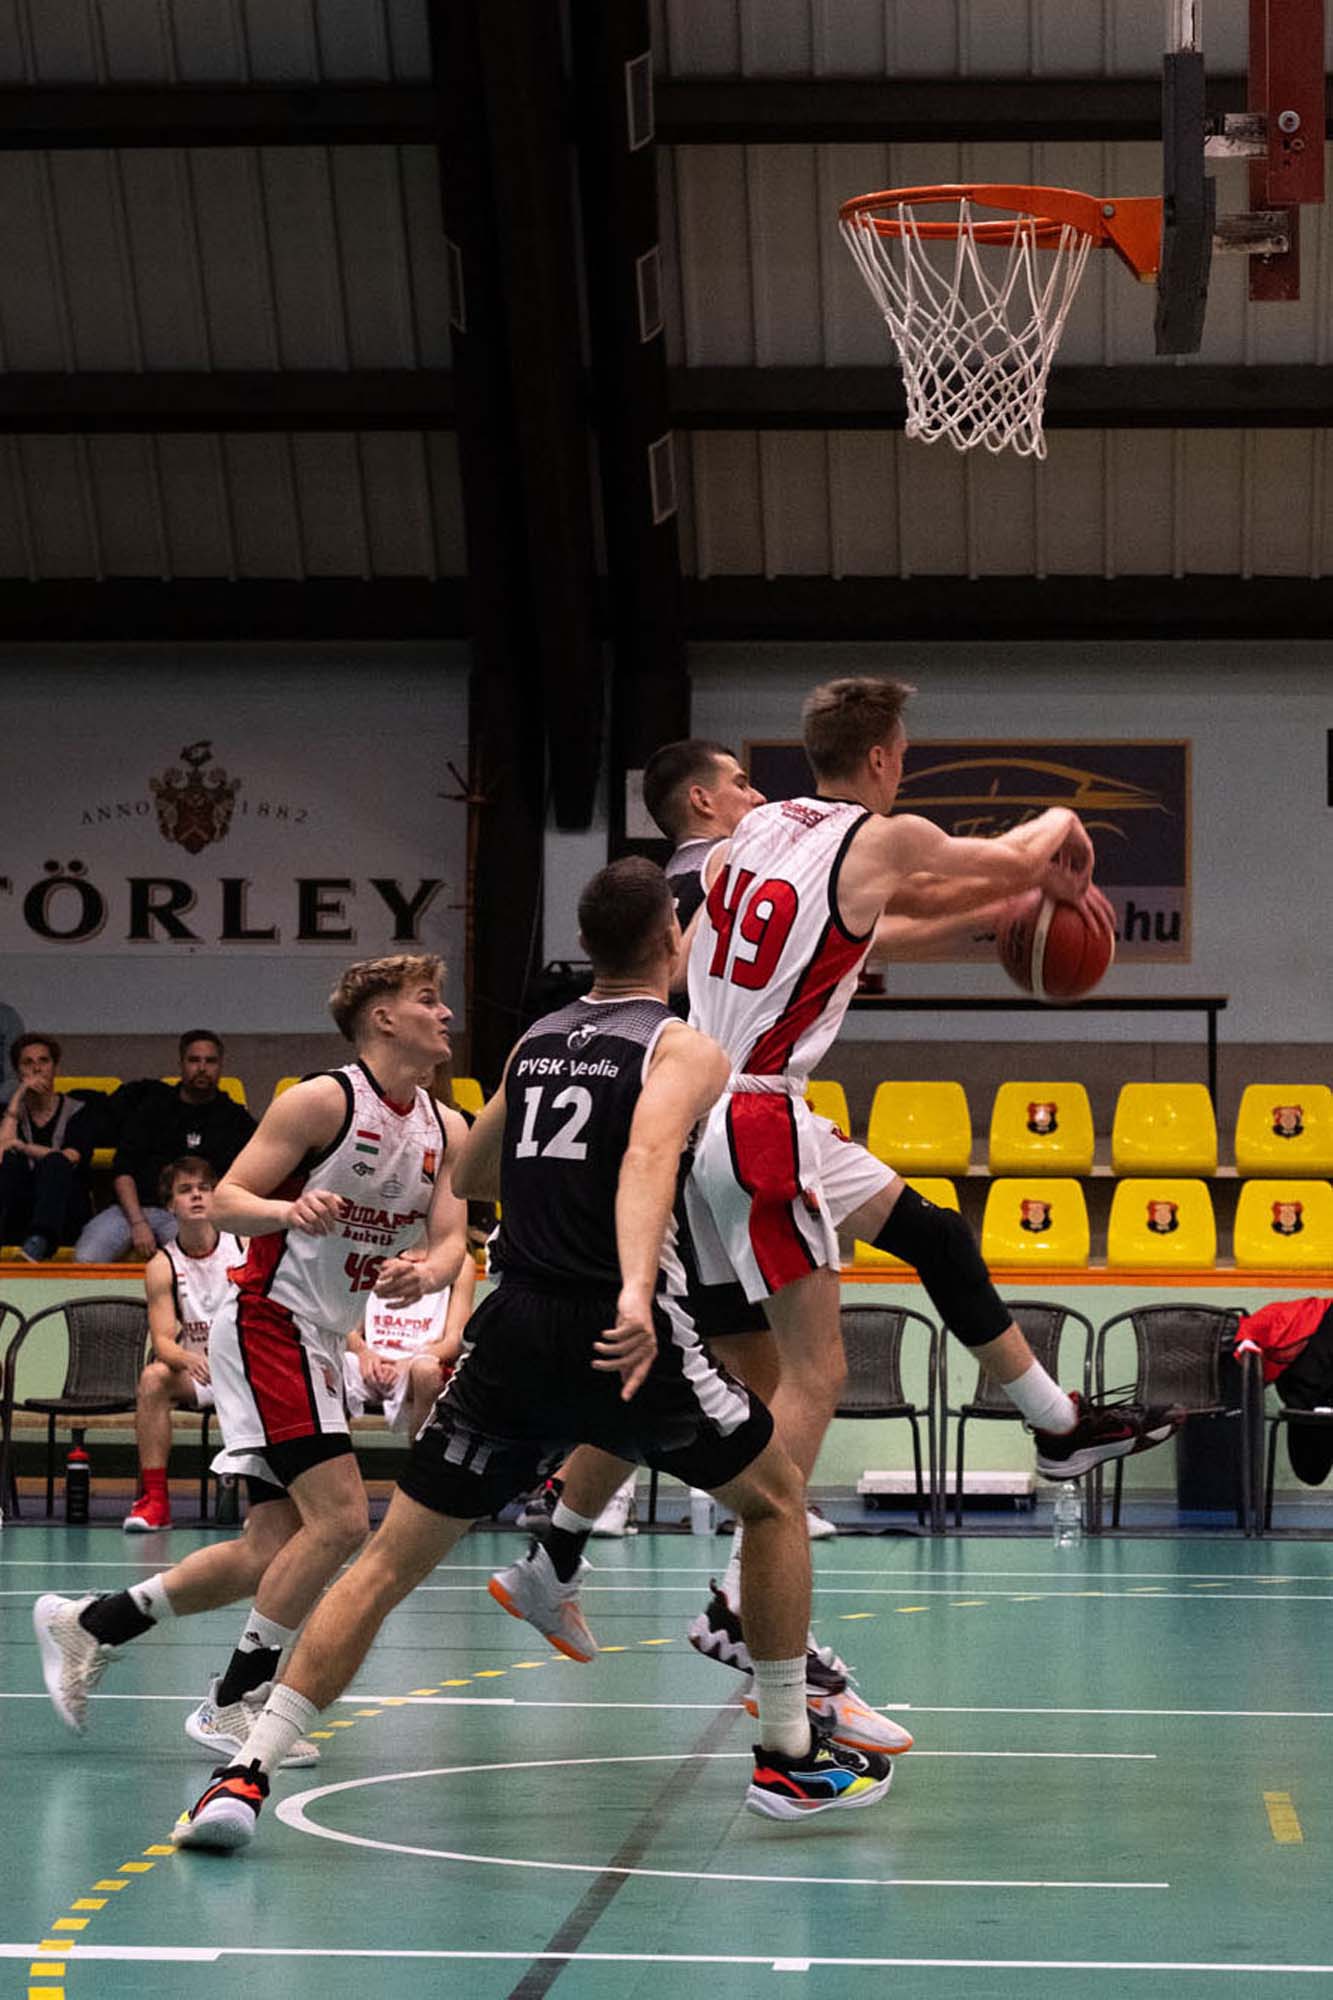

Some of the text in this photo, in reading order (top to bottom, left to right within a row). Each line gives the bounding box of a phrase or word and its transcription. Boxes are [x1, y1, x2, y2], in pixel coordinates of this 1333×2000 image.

[81, 801, 309, 825] ANNO 1882
[0, 859, 446, 945] ÖRLEY
[706, 863, 799, 991] 49
[515, 1085, 592, 1160] 12
